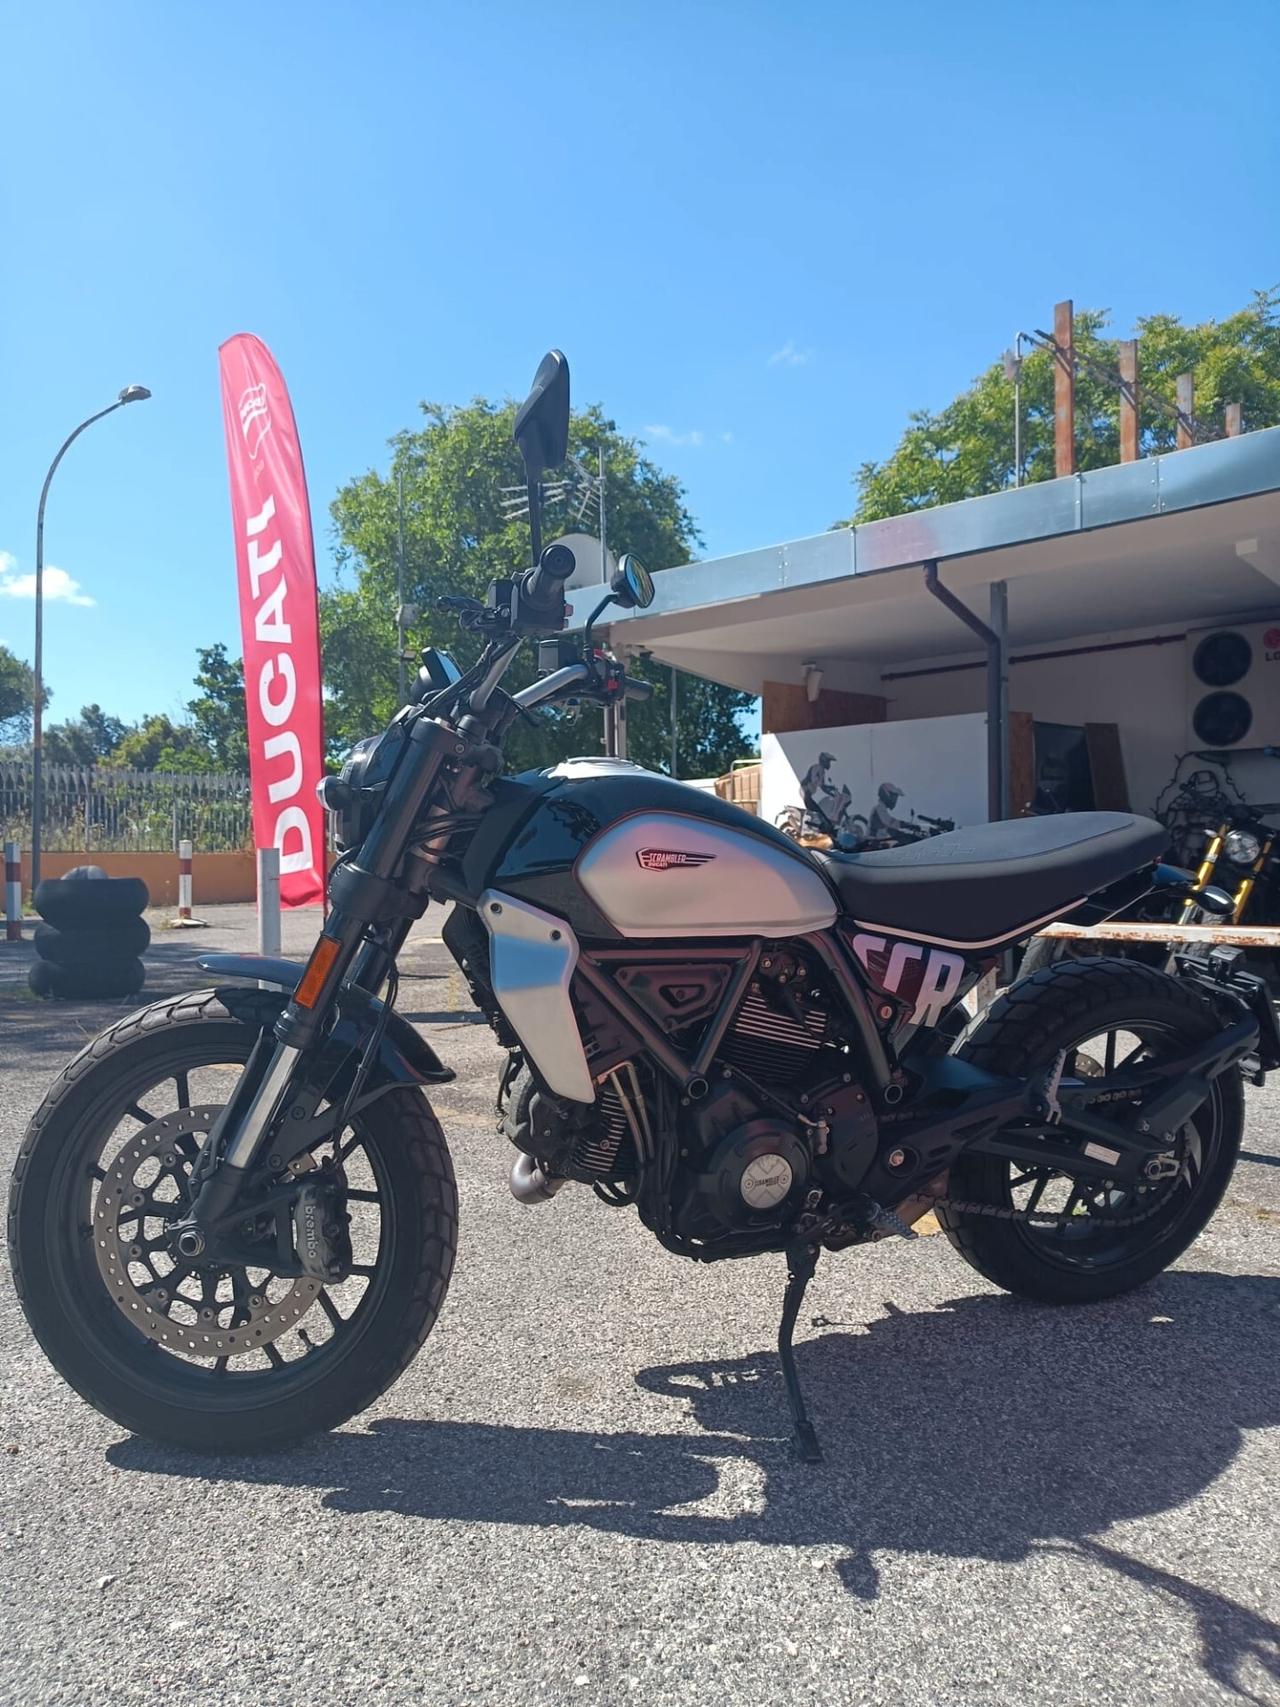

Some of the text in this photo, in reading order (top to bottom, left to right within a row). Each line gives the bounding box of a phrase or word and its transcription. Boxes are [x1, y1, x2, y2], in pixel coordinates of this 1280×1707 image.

[246, 494, 314, 875] DUCATI
[649, 853, 687, 864] SCRAMBLER
[305, 1205, 318, 1258] brembo
